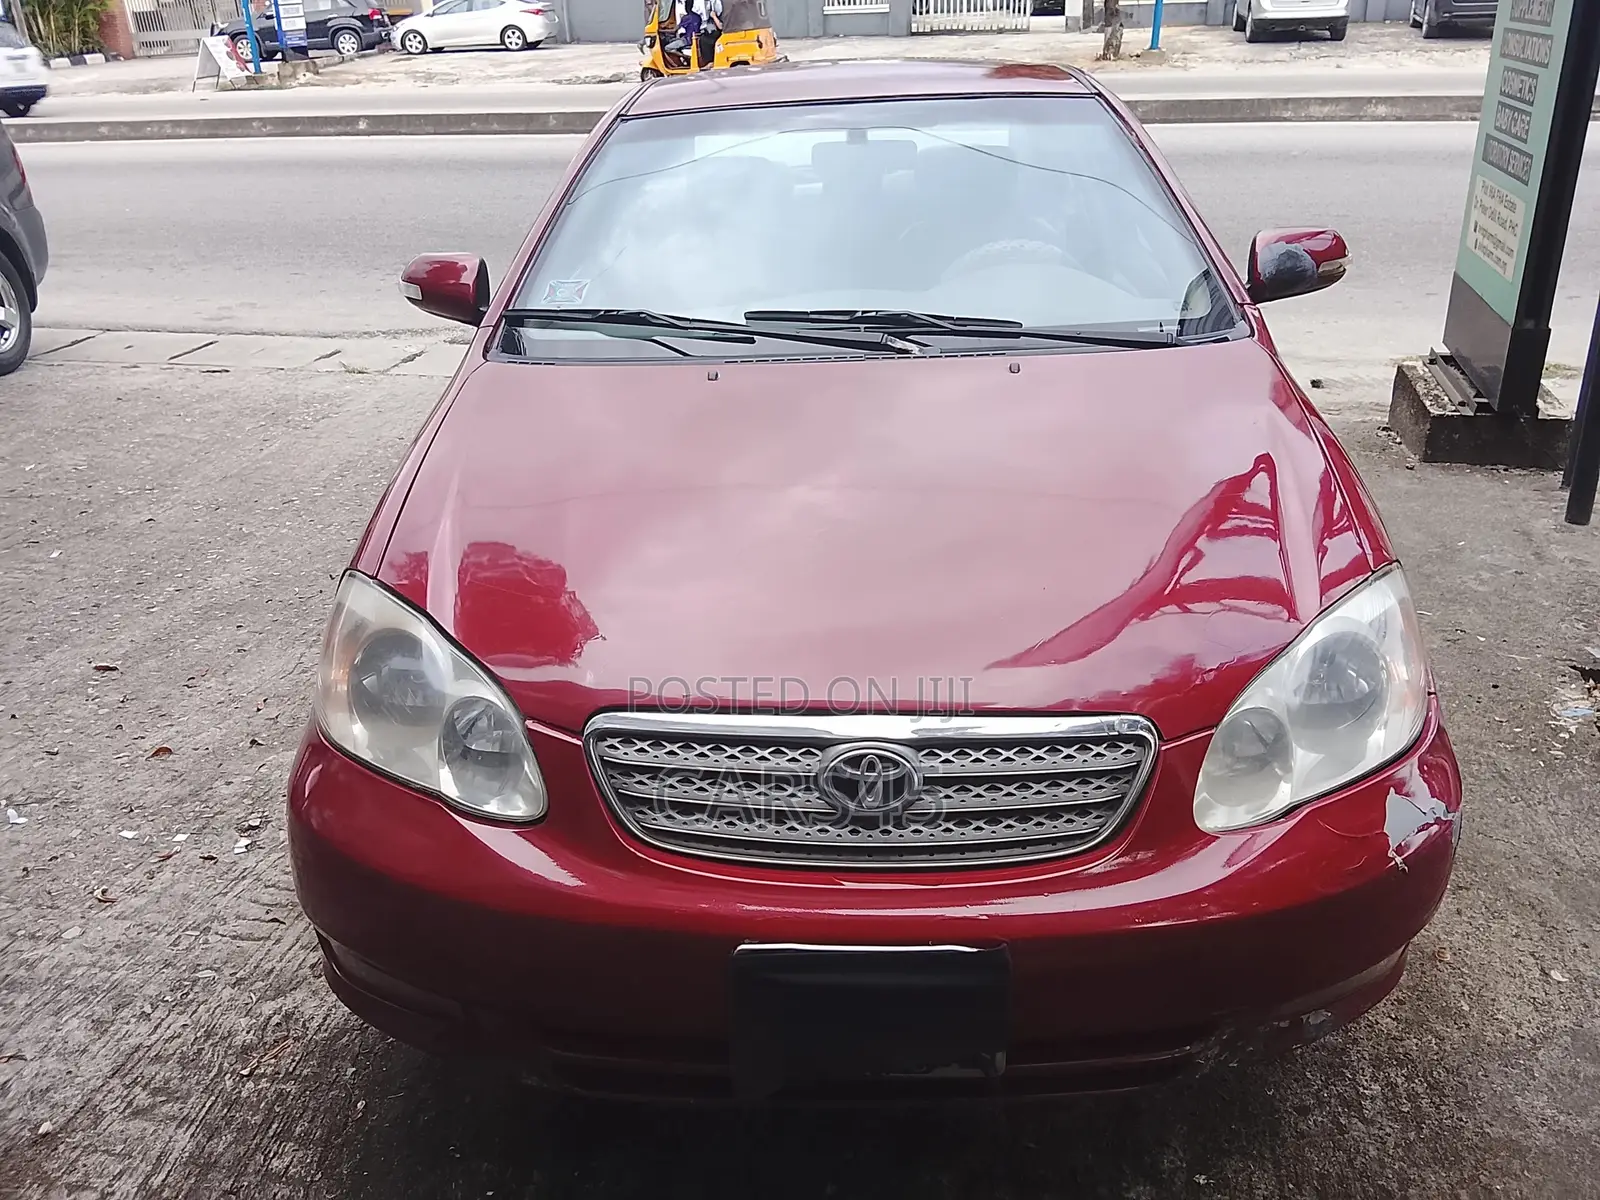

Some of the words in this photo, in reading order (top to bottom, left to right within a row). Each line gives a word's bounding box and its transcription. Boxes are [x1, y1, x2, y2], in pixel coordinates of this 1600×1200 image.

[1501, 70, 1537, 102] COSMETICS
[1496, 105, 1513, 132] BABY
[1511, 110, 1530, 140] CARE
[1484, 137, 1510, 169] BORATORY
